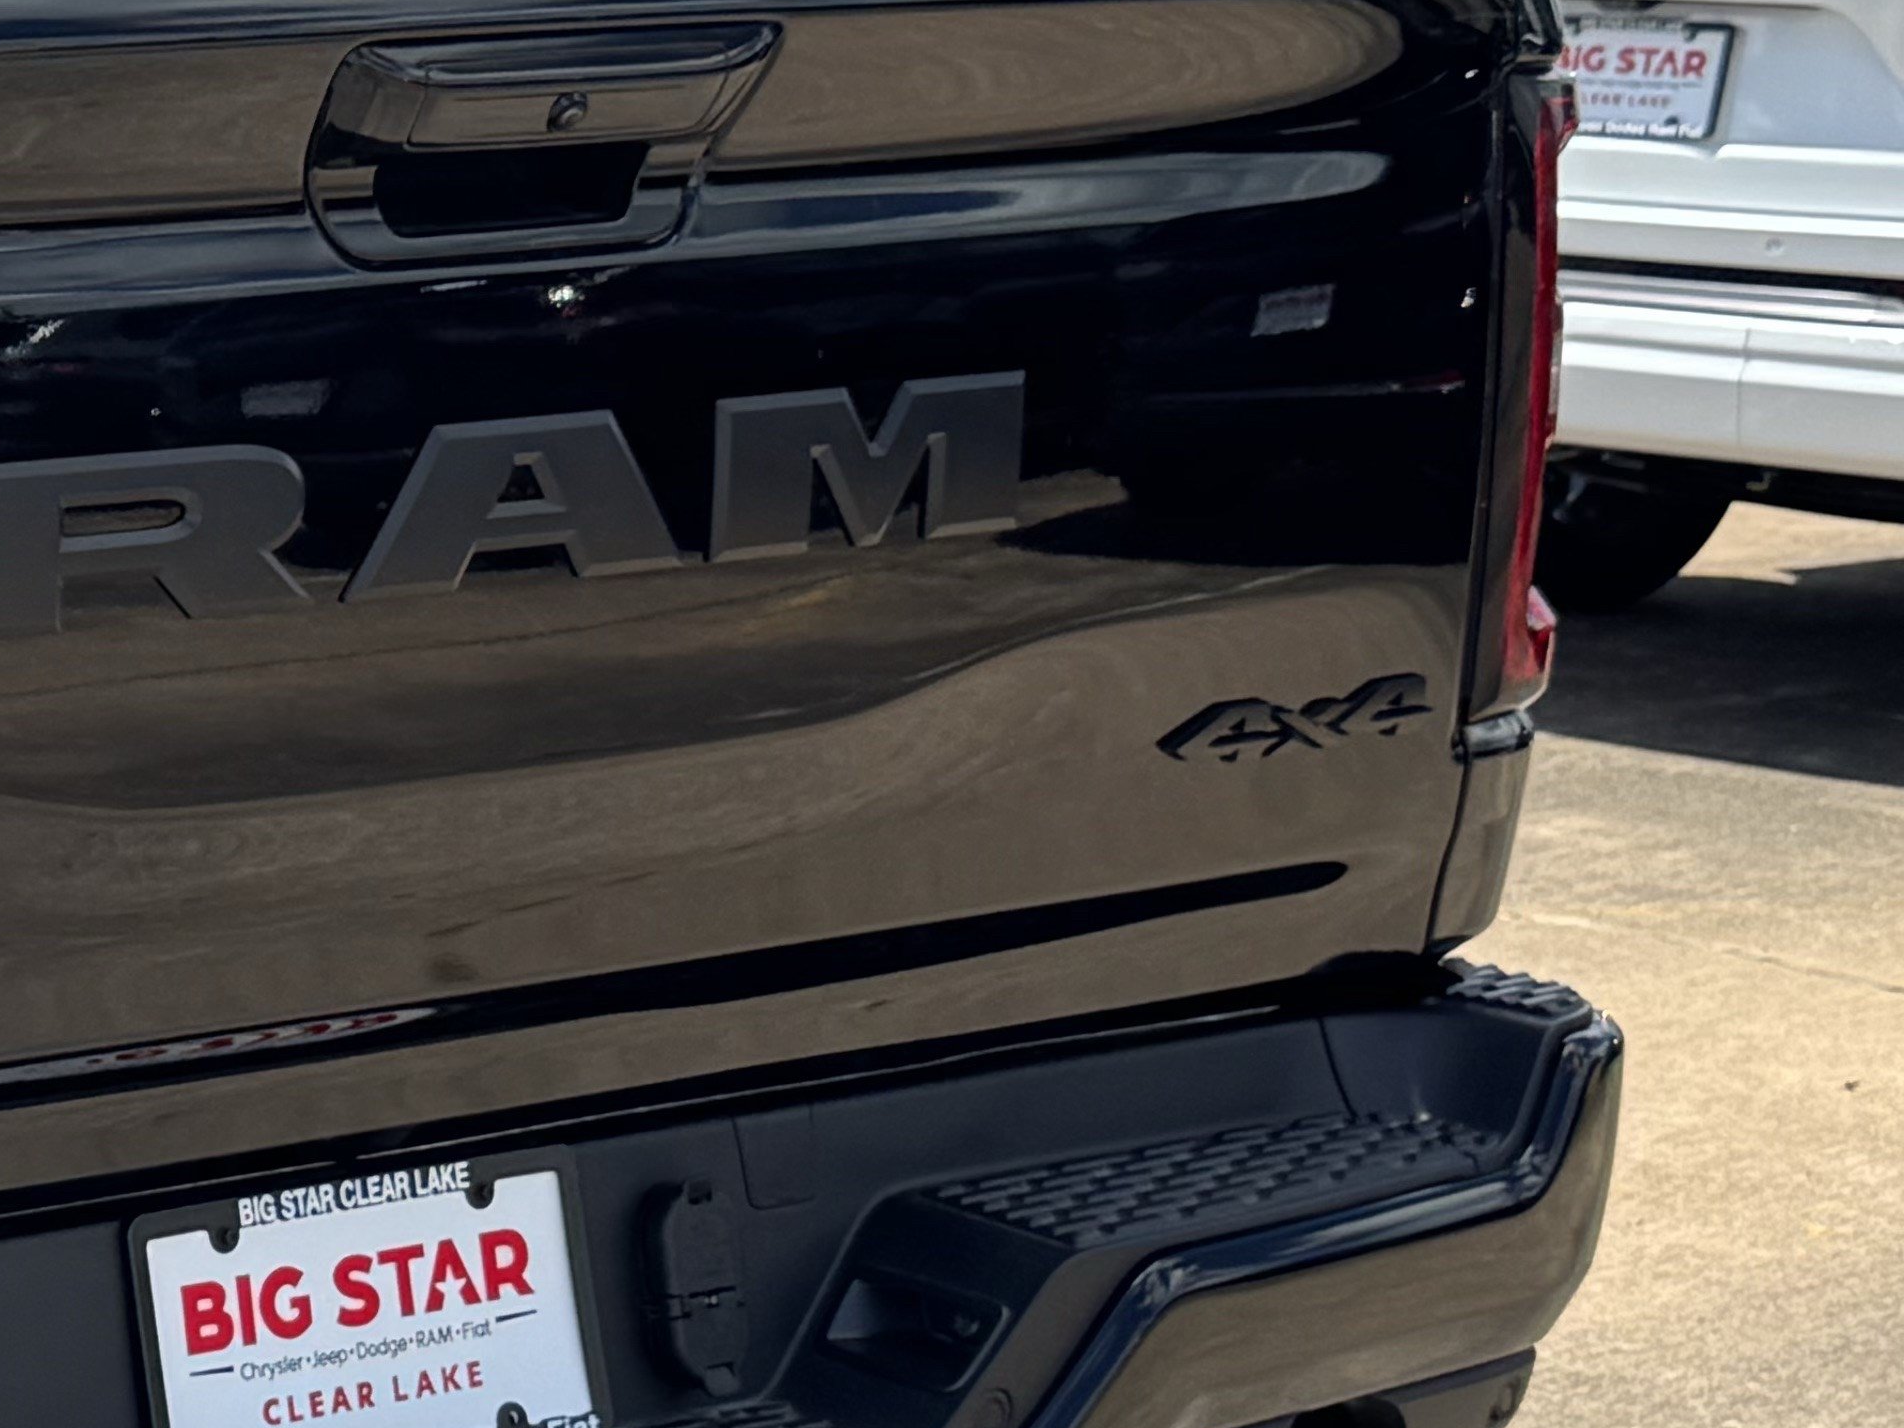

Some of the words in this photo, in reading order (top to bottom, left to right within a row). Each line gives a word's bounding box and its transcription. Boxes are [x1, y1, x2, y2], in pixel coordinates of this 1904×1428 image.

[1615, 46, 1708, 80] STAR
[238, 1195, 276, 1228] BIG
[278, 1183, 338, 1220] STAR
[339, 1170, 409, 1209] CLEAR
[413, 1161, 470, 1195] LAKE
[180, 1267, 313, 1355] BIG
[332, 1228, 534, 1327] STAR
[262, 1381, 375, 1426] CLEAR
[392, 1360, 485, 1402] LAKE
